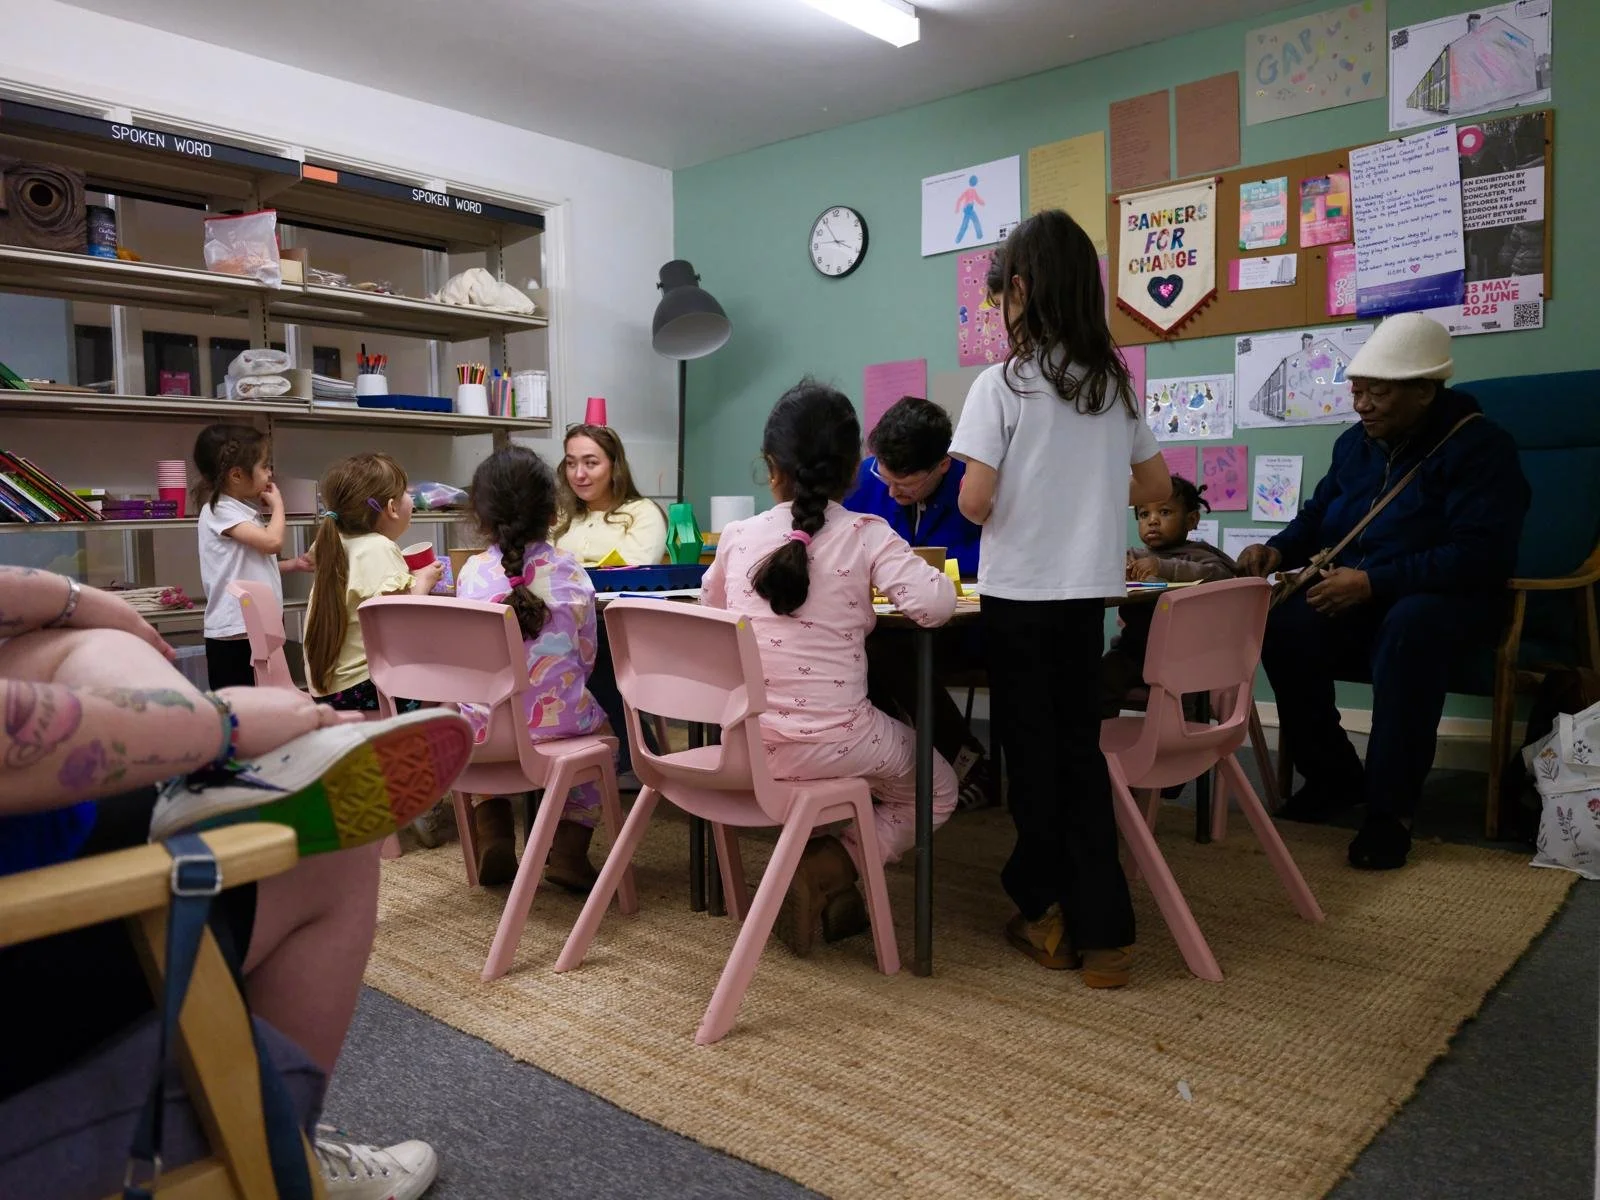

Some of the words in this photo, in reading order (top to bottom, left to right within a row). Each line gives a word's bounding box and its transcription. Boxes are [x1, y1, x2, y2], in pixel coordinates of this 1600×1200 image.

[1256, 27, 1313, 86] GAP
[111, 123, 166, 148] SPOKEN
[174, 137, 212, 159] WORD
[1475, 174, 1515, 185] EXHIBITION
[1464, 185, 1488, 193] YOUNG
[1490, 181, 1516, 189] PEOPLE
[412, 188, 450, 208] SPOKEN
[455, 196, 483, 215] WORD
[1464, 190, 1507, 201] DONCASTER,
[1464, 198, 1499, 208] EXPLORES
[1464, 205, 1497, 215] BEDROOM
[1515, 199, 1537, 207] SPACE
[832, 209, 840, 217] 12
[1128, 202, 1208, 232] BANNERS
[1388, 209, 1399, 217] play
[1464, 213, 1491, 222] CAUGHT
[1493, 208, 1527, 218] BETWEEN
[1497, 215, 1526, 224] FUTURE.
[813, 243, 819, 251] 9
[1144, 227, 1186, 254] FOR
[1371, 247, 1383, 255] play
[1443, 230, 1458, 240] really
[1128, 248, 1198, 276] CHANGE
[1464, 284, 1478, 294] 13
[1464, 295, 1480, 306] 10
[1483, 289, 1519, 304] JUNE
[1463, 304, 1498, 317] 2025
[1203, 446, 1238, 477] GAP
